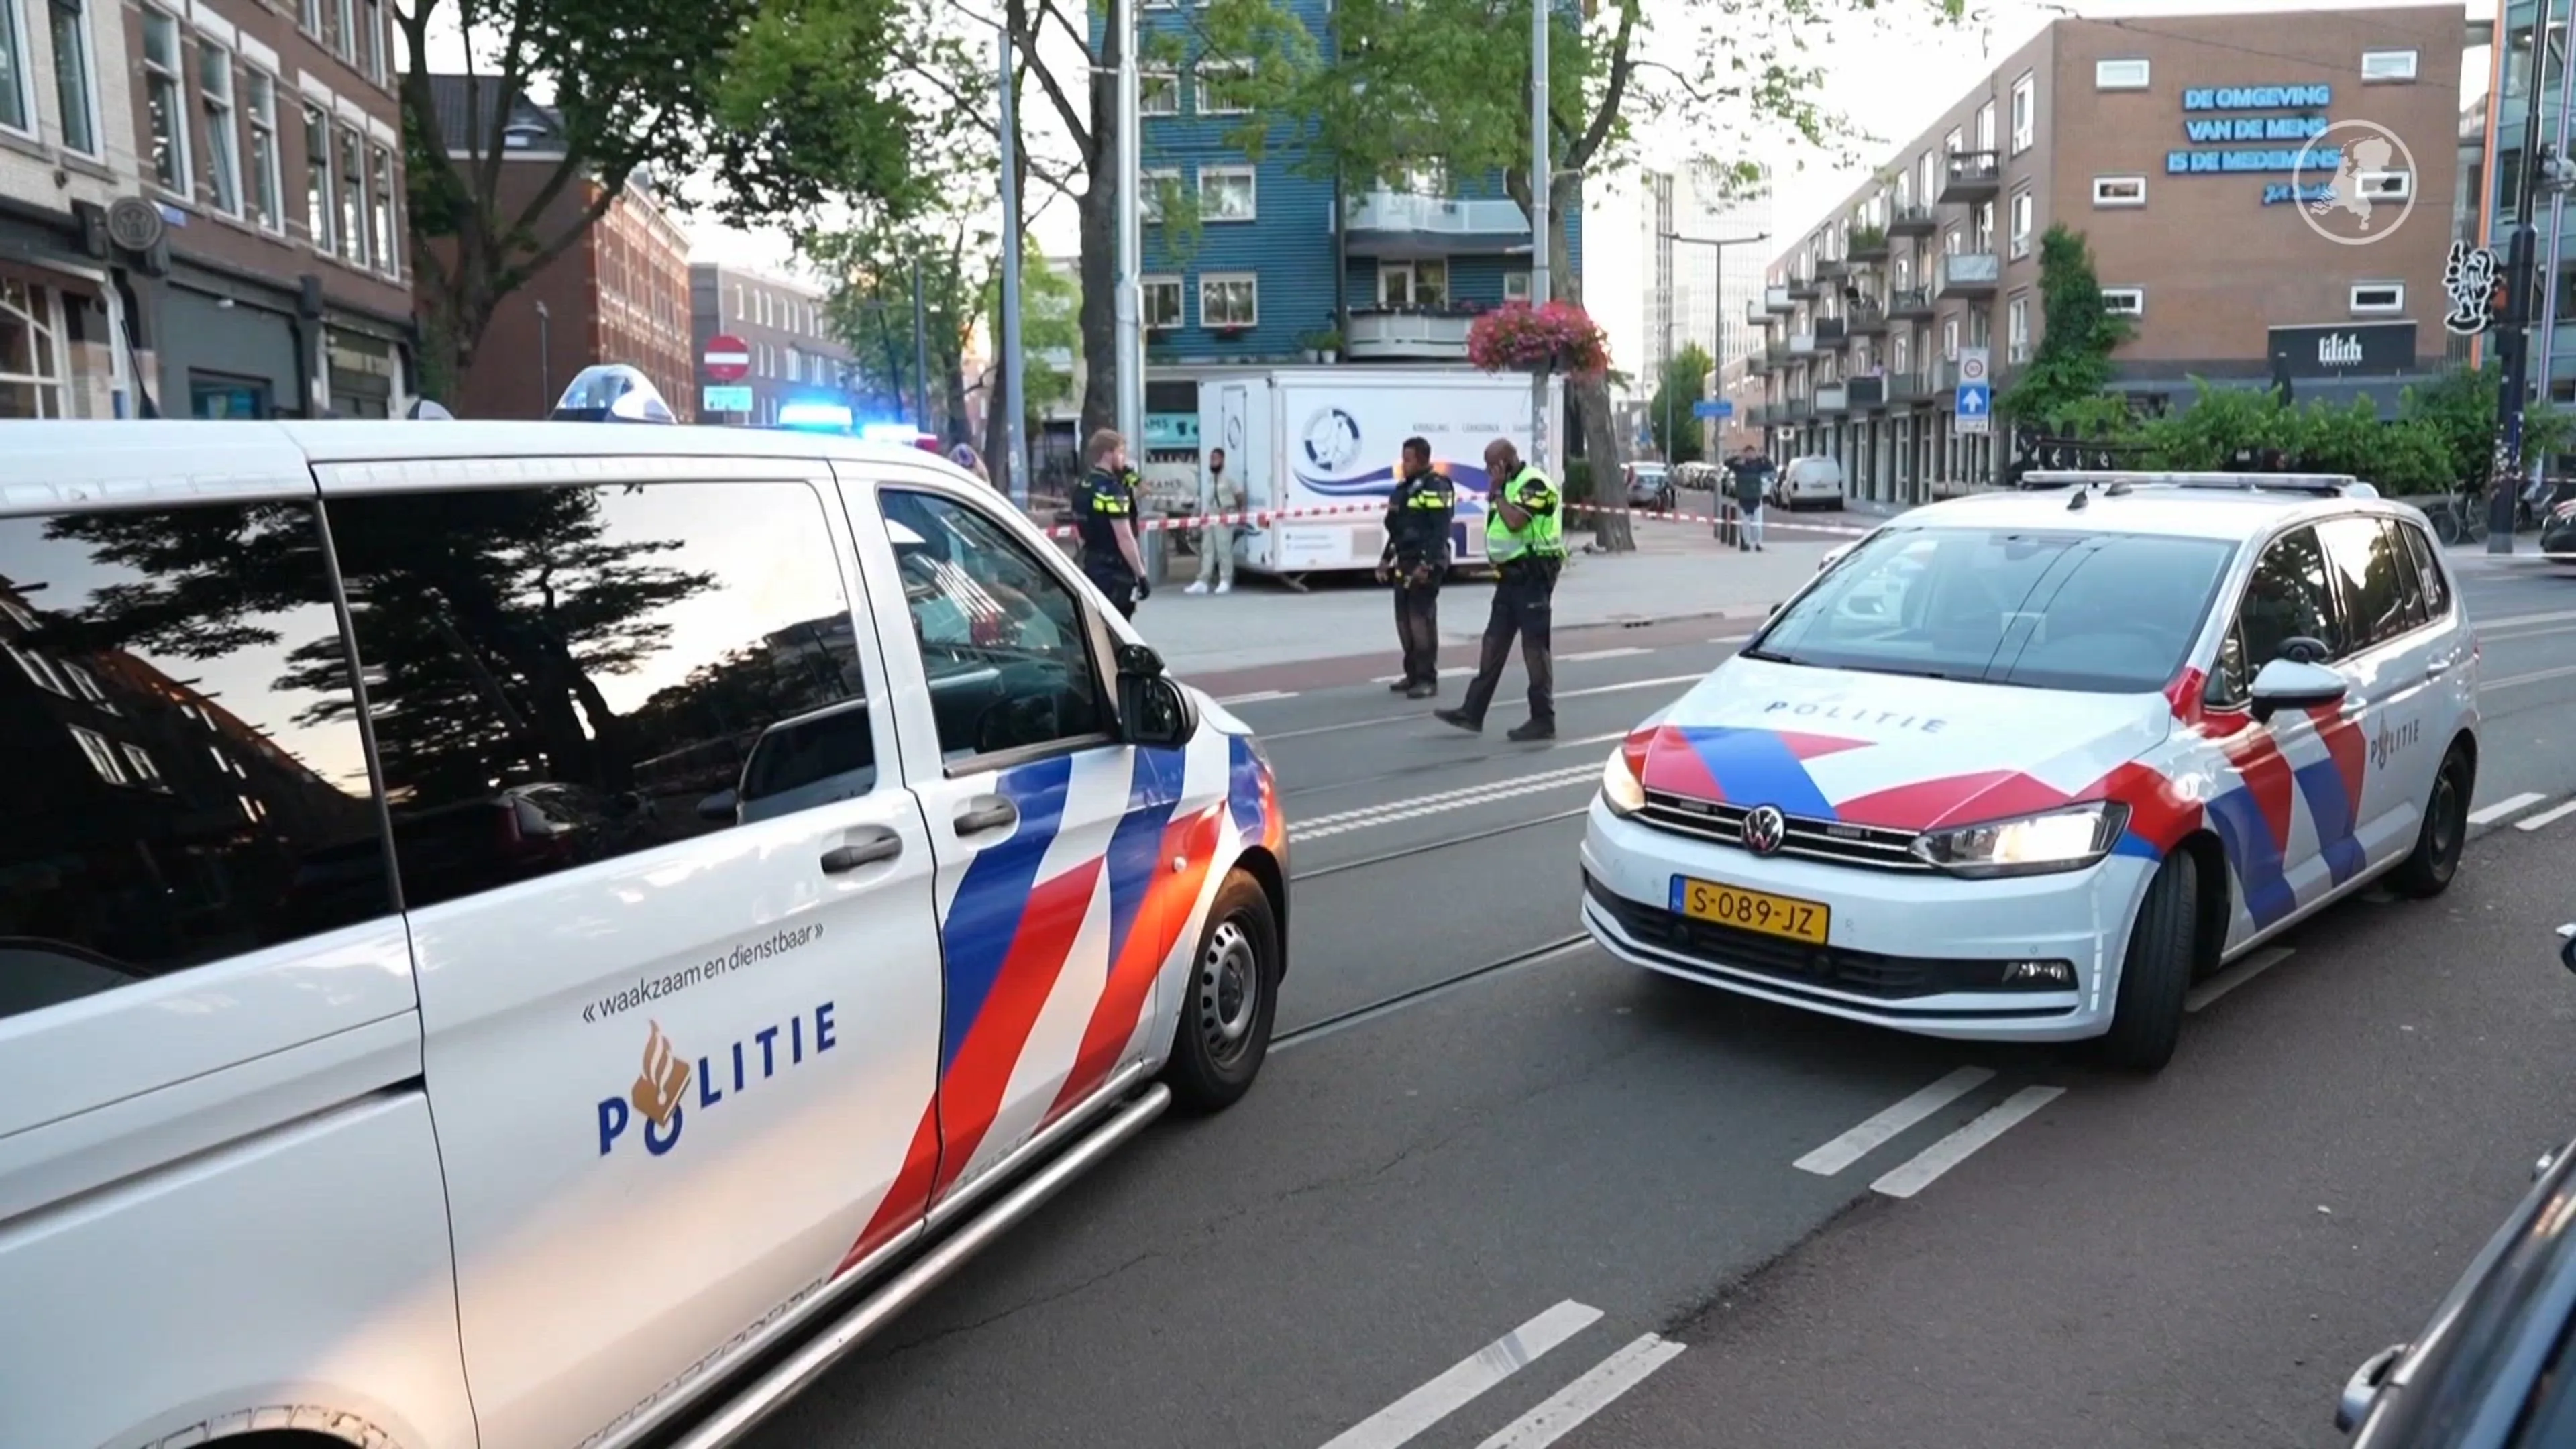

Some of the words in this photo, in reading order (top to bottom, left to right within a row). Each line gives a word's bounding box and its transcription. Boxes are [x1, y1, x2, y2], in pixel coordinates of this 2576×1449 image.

[2184, 89, 2214, 109] DE
[2215, 85, 2330, 107] OMGEVING
[2186, 119, 2232, 142] VAN
[2233, 118, 2265, 140] DE
[2265, 117, 2328, 139] MENS
[2167, 151, 2189, 172] IS
[2190, 150, 2220, 172] DE
[2221, 148, 2341, 170] MEDEMENS
[1764, 701, 1948, 733] POLITIE
[2370, 718, 2420, 771] POLITIE
[1693, 886, 1815, 936] S-089-JZ
[704, 960, 726, 979] en
[598, 1000, 837, 1157] POLITIE
